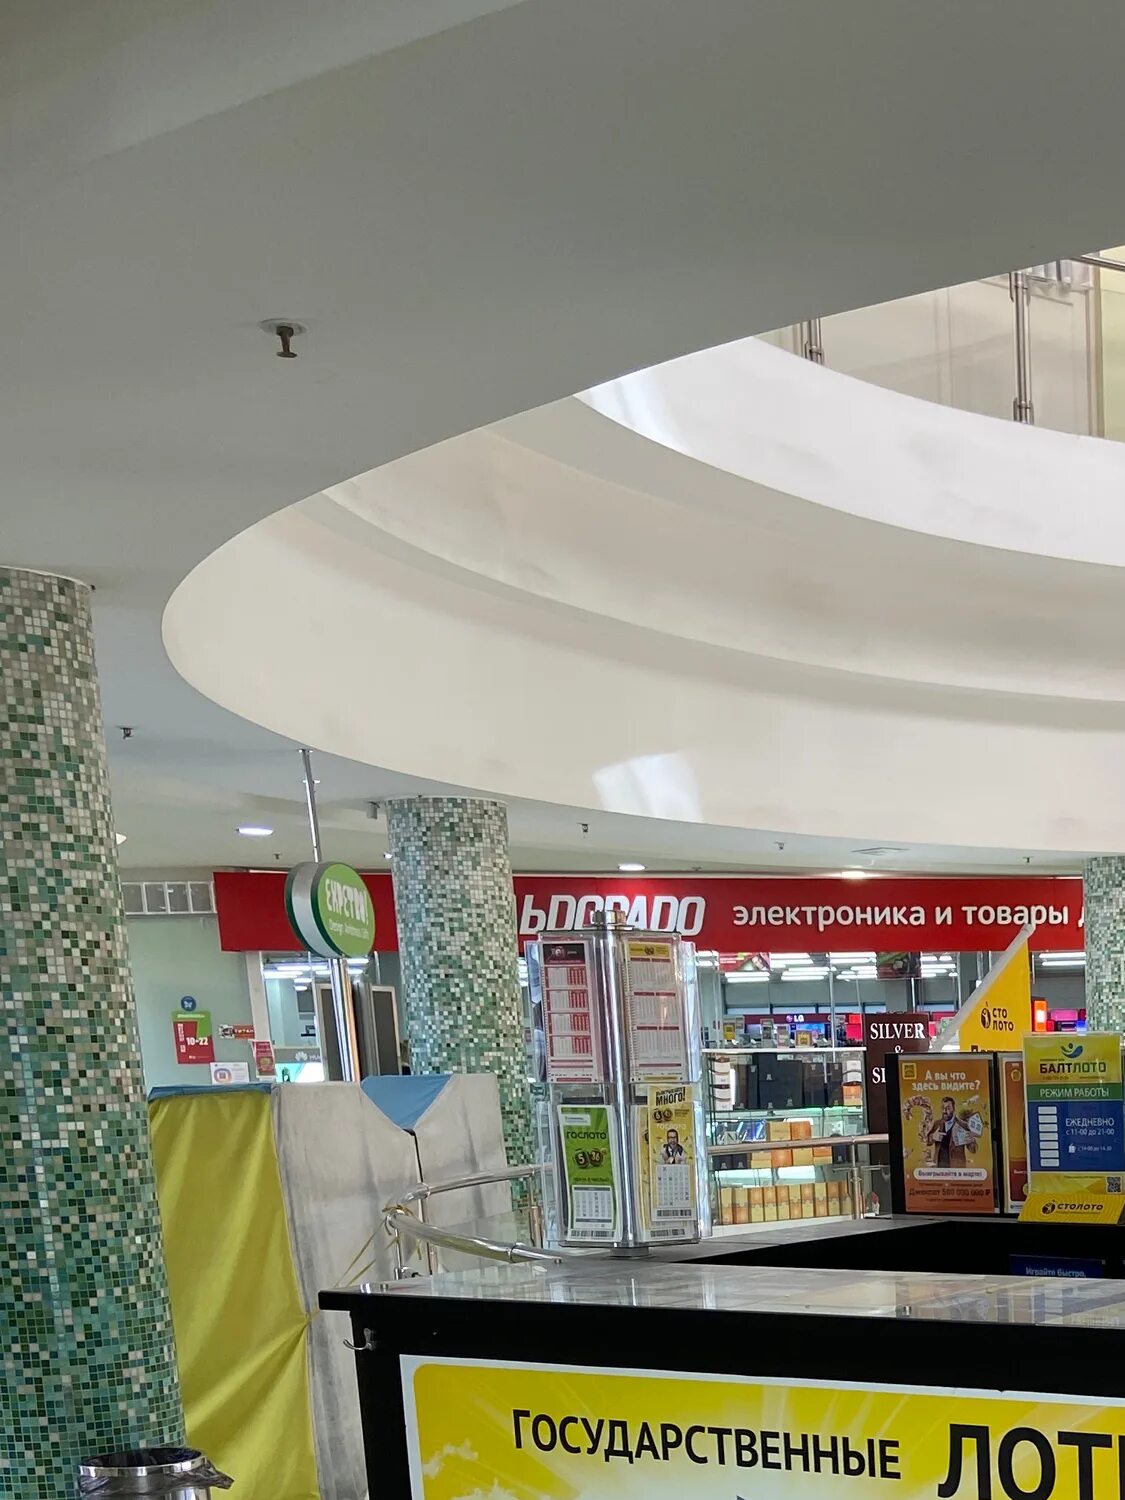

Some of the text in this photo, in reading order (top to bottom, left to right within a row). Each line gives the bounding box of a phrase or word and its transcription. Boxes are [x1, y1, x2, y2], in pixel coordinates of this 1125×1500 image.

[733, 905, 924, 931] электроника
[935, 906, 952, 925] и
[962, 905, 1068, 932] товары
[871, 1023, 925, 1039] SILVER
[993, 1021, 1014, 1031] ЛОТО
[1040, 1062, 1106, 1074] БАЛТЛОТО
[925, 1071, 965, 1080] А вы что
[912, 1080, 980, 1091] здесь видите?
[1040, 1088, 1109, 1097] РЕЖИМ РАБОТЫ
[1066, 1118, 1114, 1127] ЕЖЕДНЕВНО
[1057, 1203, 1103, 1211] СТОЛОТО
[513, 1409, 901, 1480] ГОСУДАРСТВЕННЫЕ
